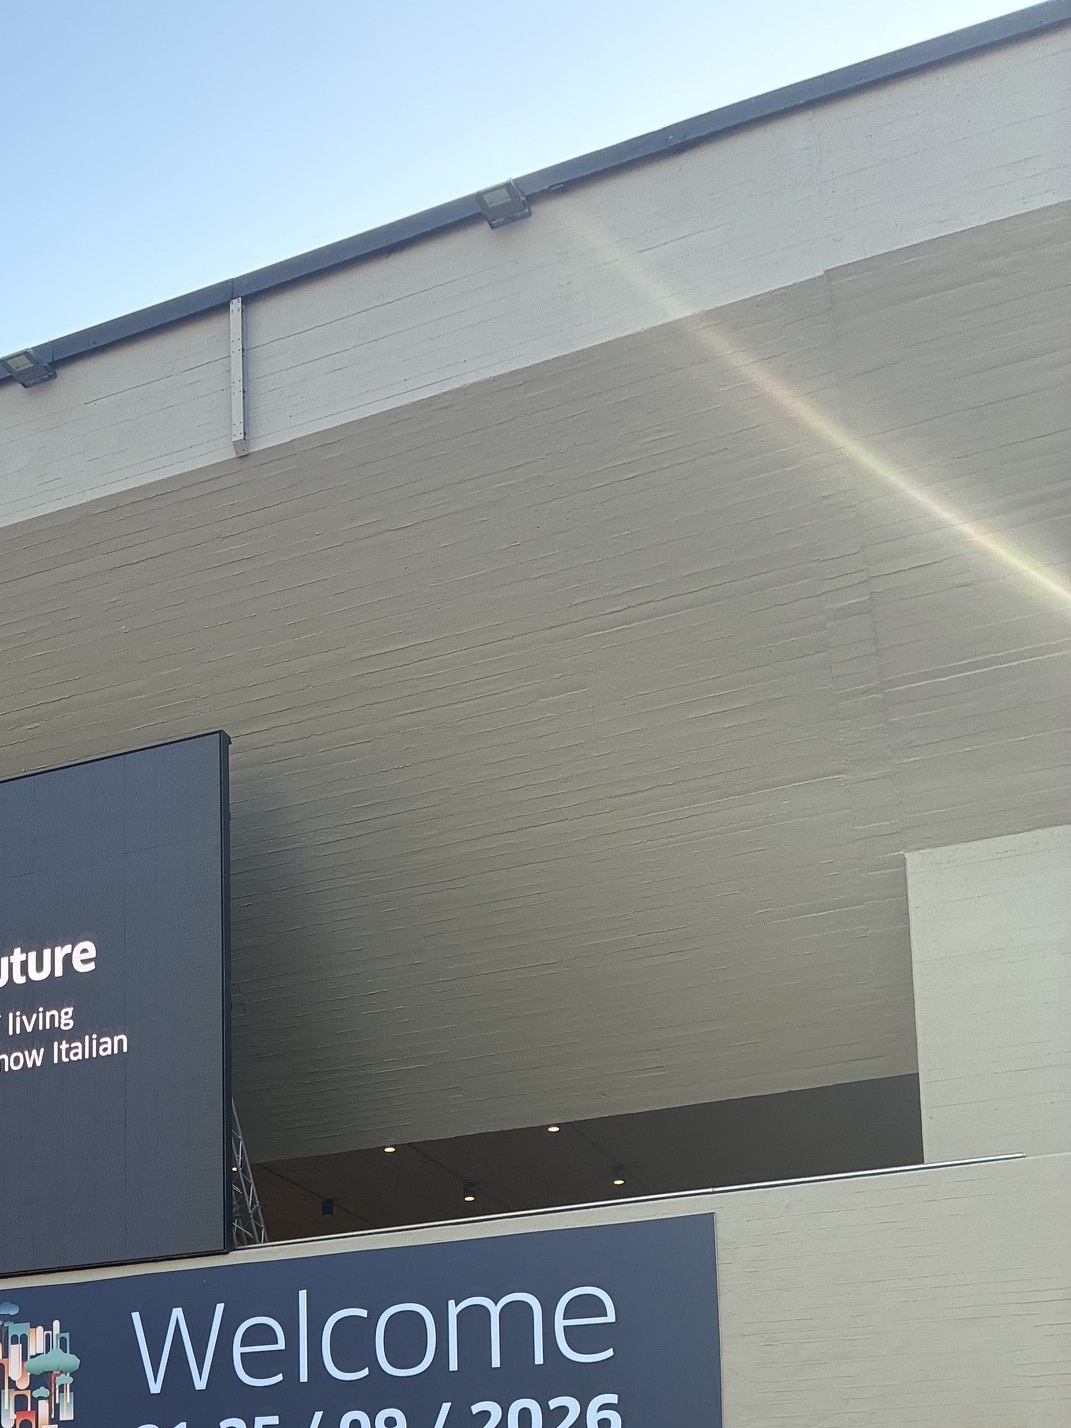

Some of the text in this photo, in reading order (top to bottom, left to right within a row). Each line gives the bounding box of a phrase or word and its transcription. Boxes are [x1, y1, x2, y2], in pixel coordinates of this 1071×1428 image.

[8, 1006, 74, 1036] living
[53, 1034, 128, 1064] Italian
[131, 1286, 616, 1394] Welcome
